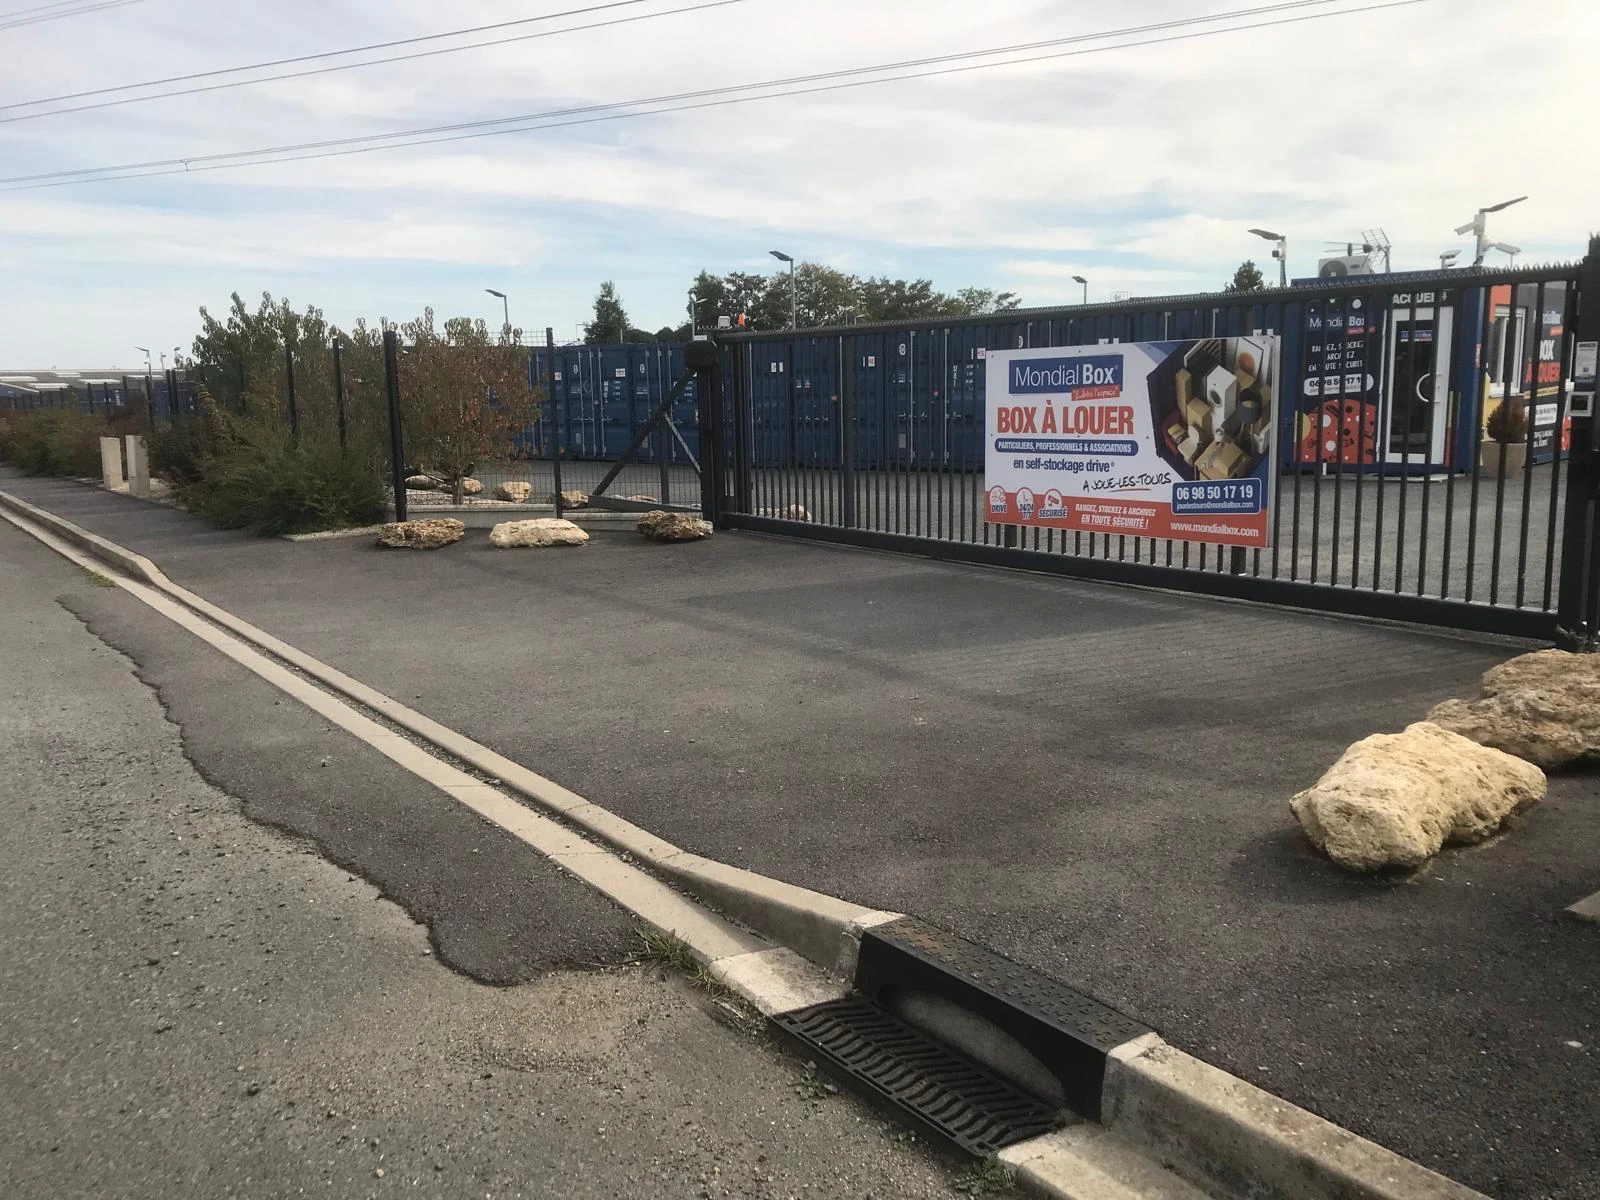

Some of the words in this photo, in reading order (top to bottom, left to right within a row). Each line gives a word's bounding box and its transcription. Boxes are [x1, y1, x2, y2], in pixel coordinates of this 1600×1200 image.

[1540, 340, 1555, 360] OX
[1538, 362, 1560, 383] OUER
[997, 406, 1037, 434] BOX
[1041, 400, 1057, 434] À
[1062, 406, 1134, 434] LOUER
[998, 441, 1035, 452] PARTICULIERS,
[1036, 442, 1083, 452] PROFESSIONNELS
[1084, 443, 1088, 452] &
[1090, 443, 1132, 452] ASSOCIATIONS
[1014, 460, 1024, 469] en
[1025, 458, 1085, 473] self-stockage
[1177, 488, 1189, 500] 06
[1192, 487, 1205, 499] 98
[1208, 486, 1220, 499] 50
[1224, 486, 1236, 498] 17
[1240, 485, 1253, 498] 19
[992, 504, 1007, 512] DRIVE
[1019, 504, 1034, 512] 24/24
[1039, 506, 1066, 518] SÉCURISÉ
[1075, 504, 1097, 514] RANGEZ,
[1098, 505, 1122, 514] STOCKEZ
[1128, 507, 1156, 516] ARCHIVEZ
[1081, 514, 1090, 522] EN
[1092, 515, 1111, 525] TOUTE
[1112, 516, 1144, 527] SÉCURITÉ
[1170, 522, 1259, 536] www.mondialbox.com
